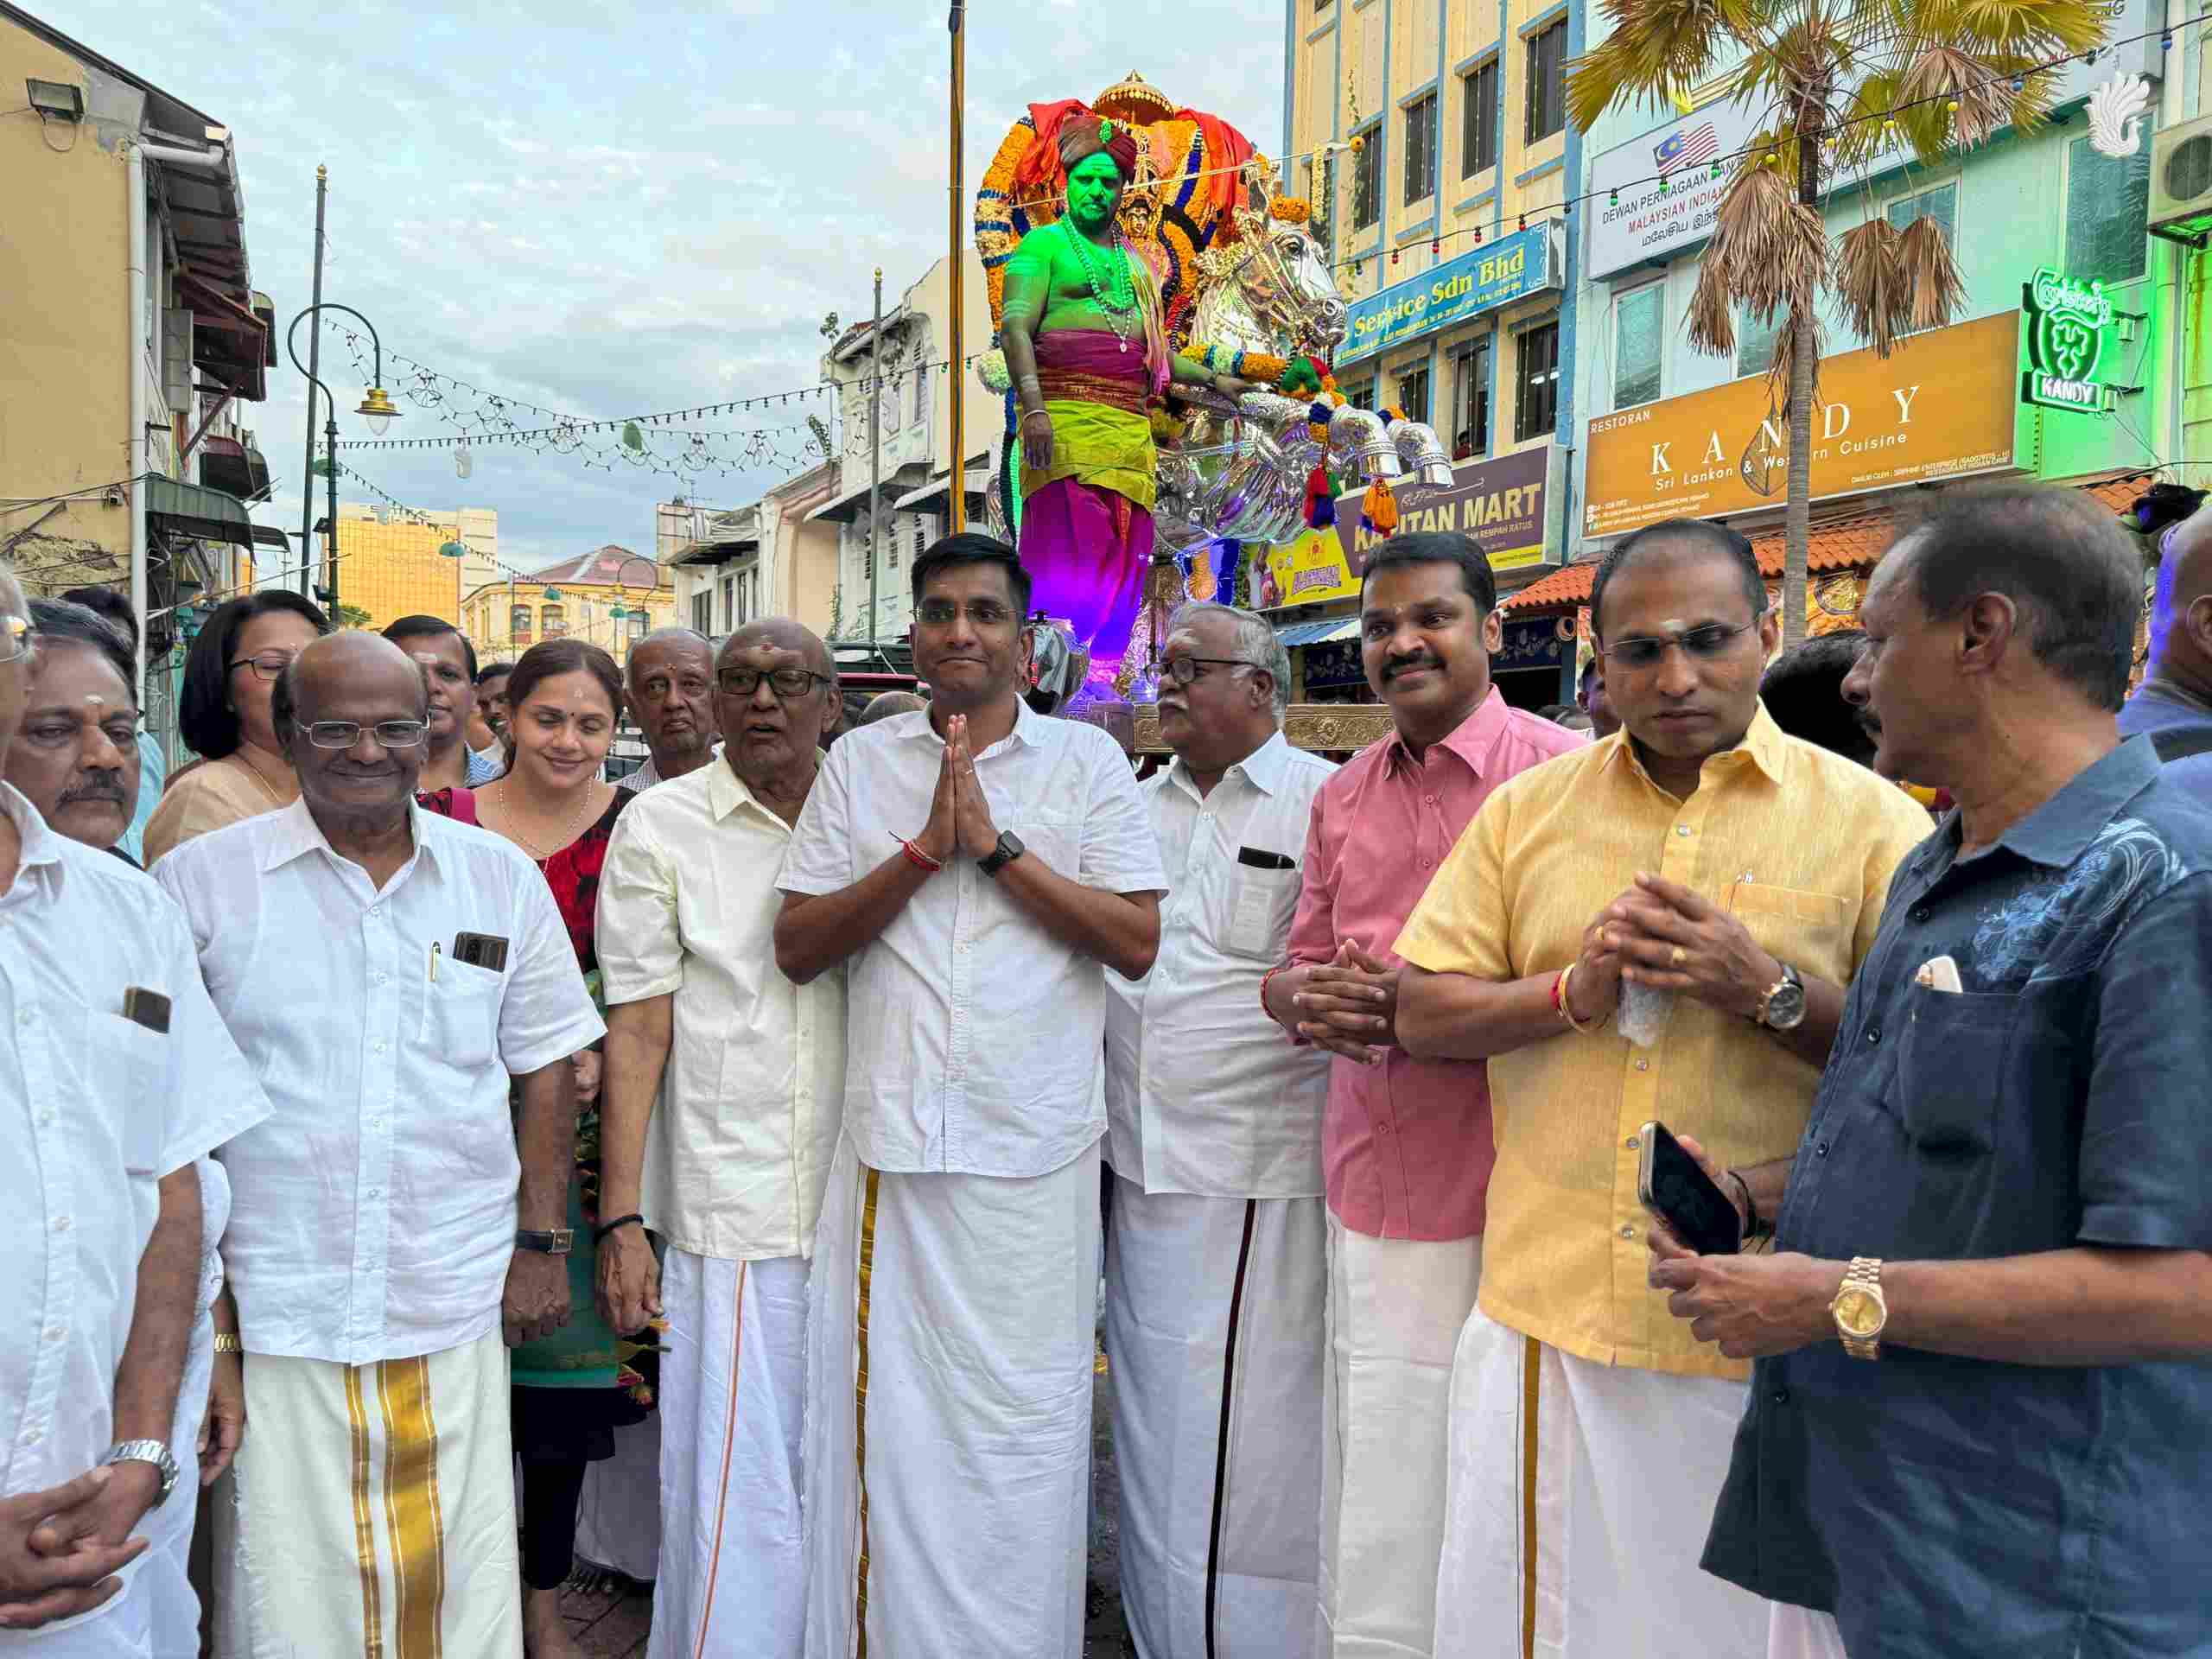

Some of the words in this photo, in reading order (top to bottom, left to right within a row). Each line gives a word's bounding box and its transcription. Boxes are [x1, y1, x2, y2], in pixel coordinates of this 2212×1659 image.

[1603, 200, 1639, 225] DEWAN
[1640, 170, 1708, 208] PERNIAGAAN
[1628, 200, 1686, 234] MALAYSIAN
[1354, 290, 1426, 338] Service
[1431, 271, 1473, 303] Sdn
[1478, 247, 1525, 287] Bhd
[2042, 376, 2095, 405] KANDY
[1590, 410, 1651, 433] RESTORAN
[1651, 385, 1921, 475] KANDY
[1656, 476, 1675, 491] Sri
[1684, 467, 1733, 486] Lankan
[1742, 458, 1753, 474] &
[1840, 433, 1908, 455] Cuisine
[1463, 483, 1542, 530] MART
